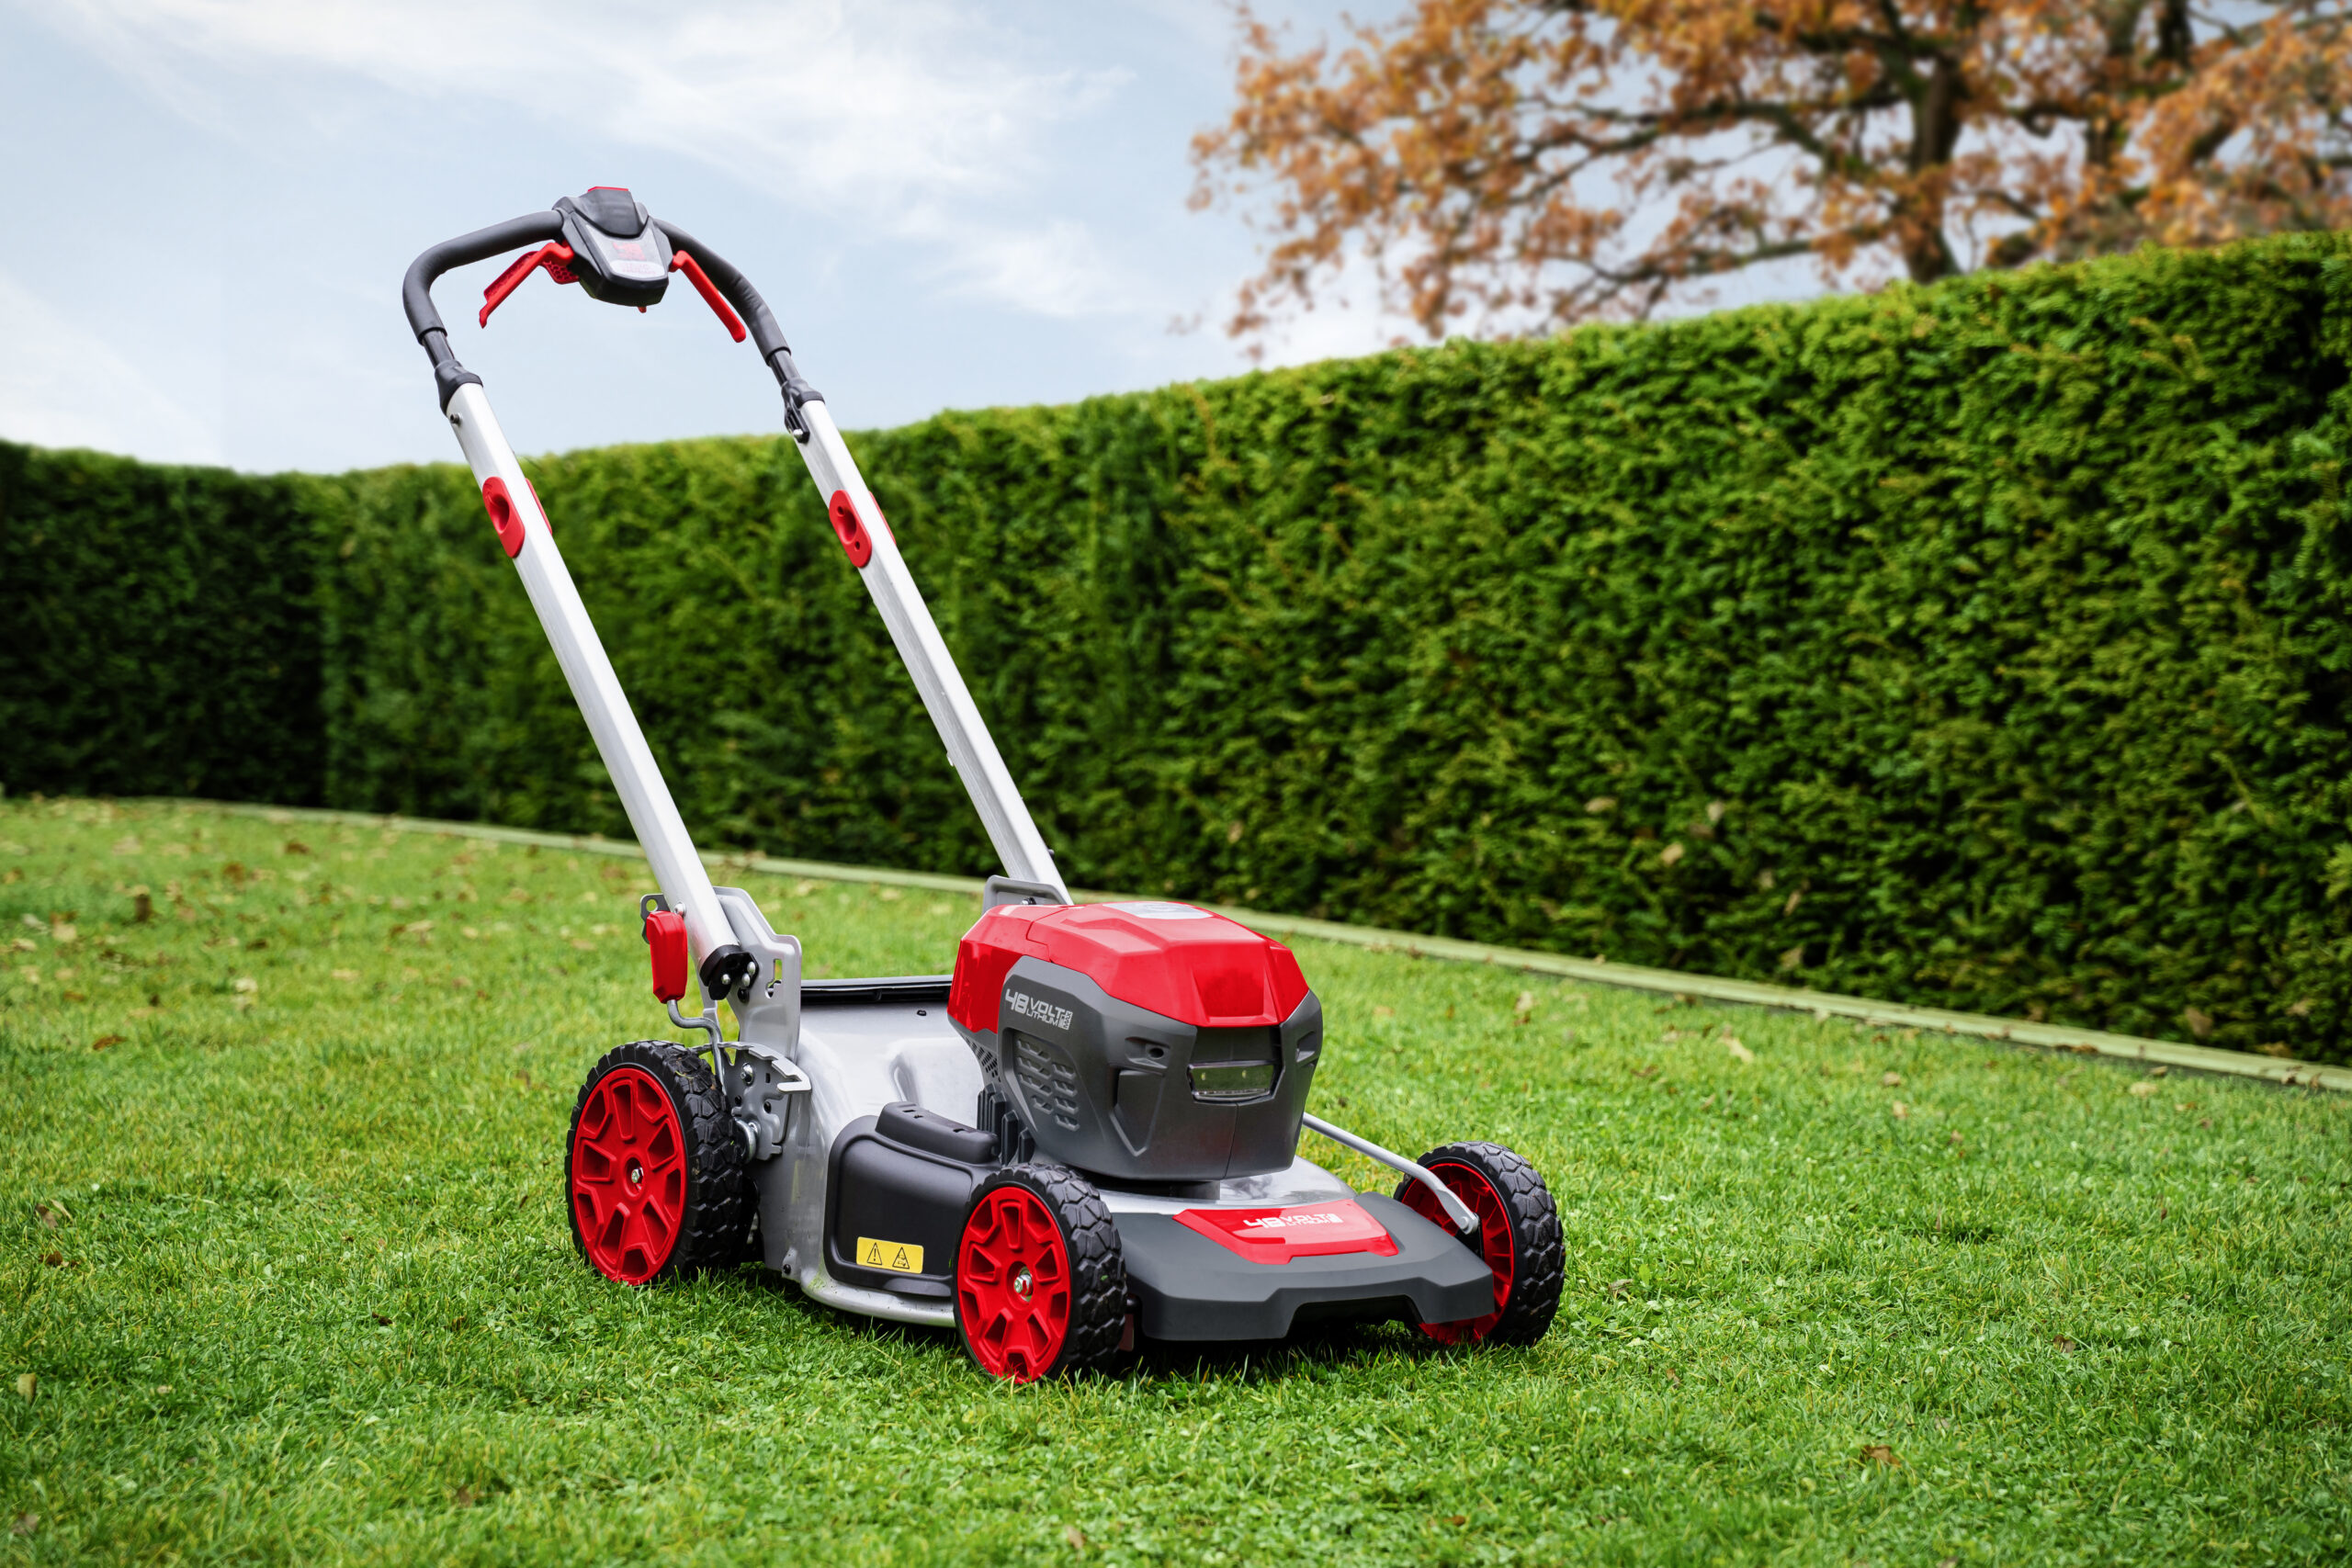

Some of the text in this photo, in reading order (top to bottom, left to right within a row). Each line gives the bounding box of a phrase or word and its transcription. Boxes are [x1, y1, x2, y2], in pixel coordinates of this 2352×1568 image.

[1005, 988, 1065, 1019] 48 VOLT
[1026, 1009, 1058, 1026] LITHIUM
[1243, 1217, 1286, 1228] 48
[1281, 1213, 1328, 1223] VOLT
